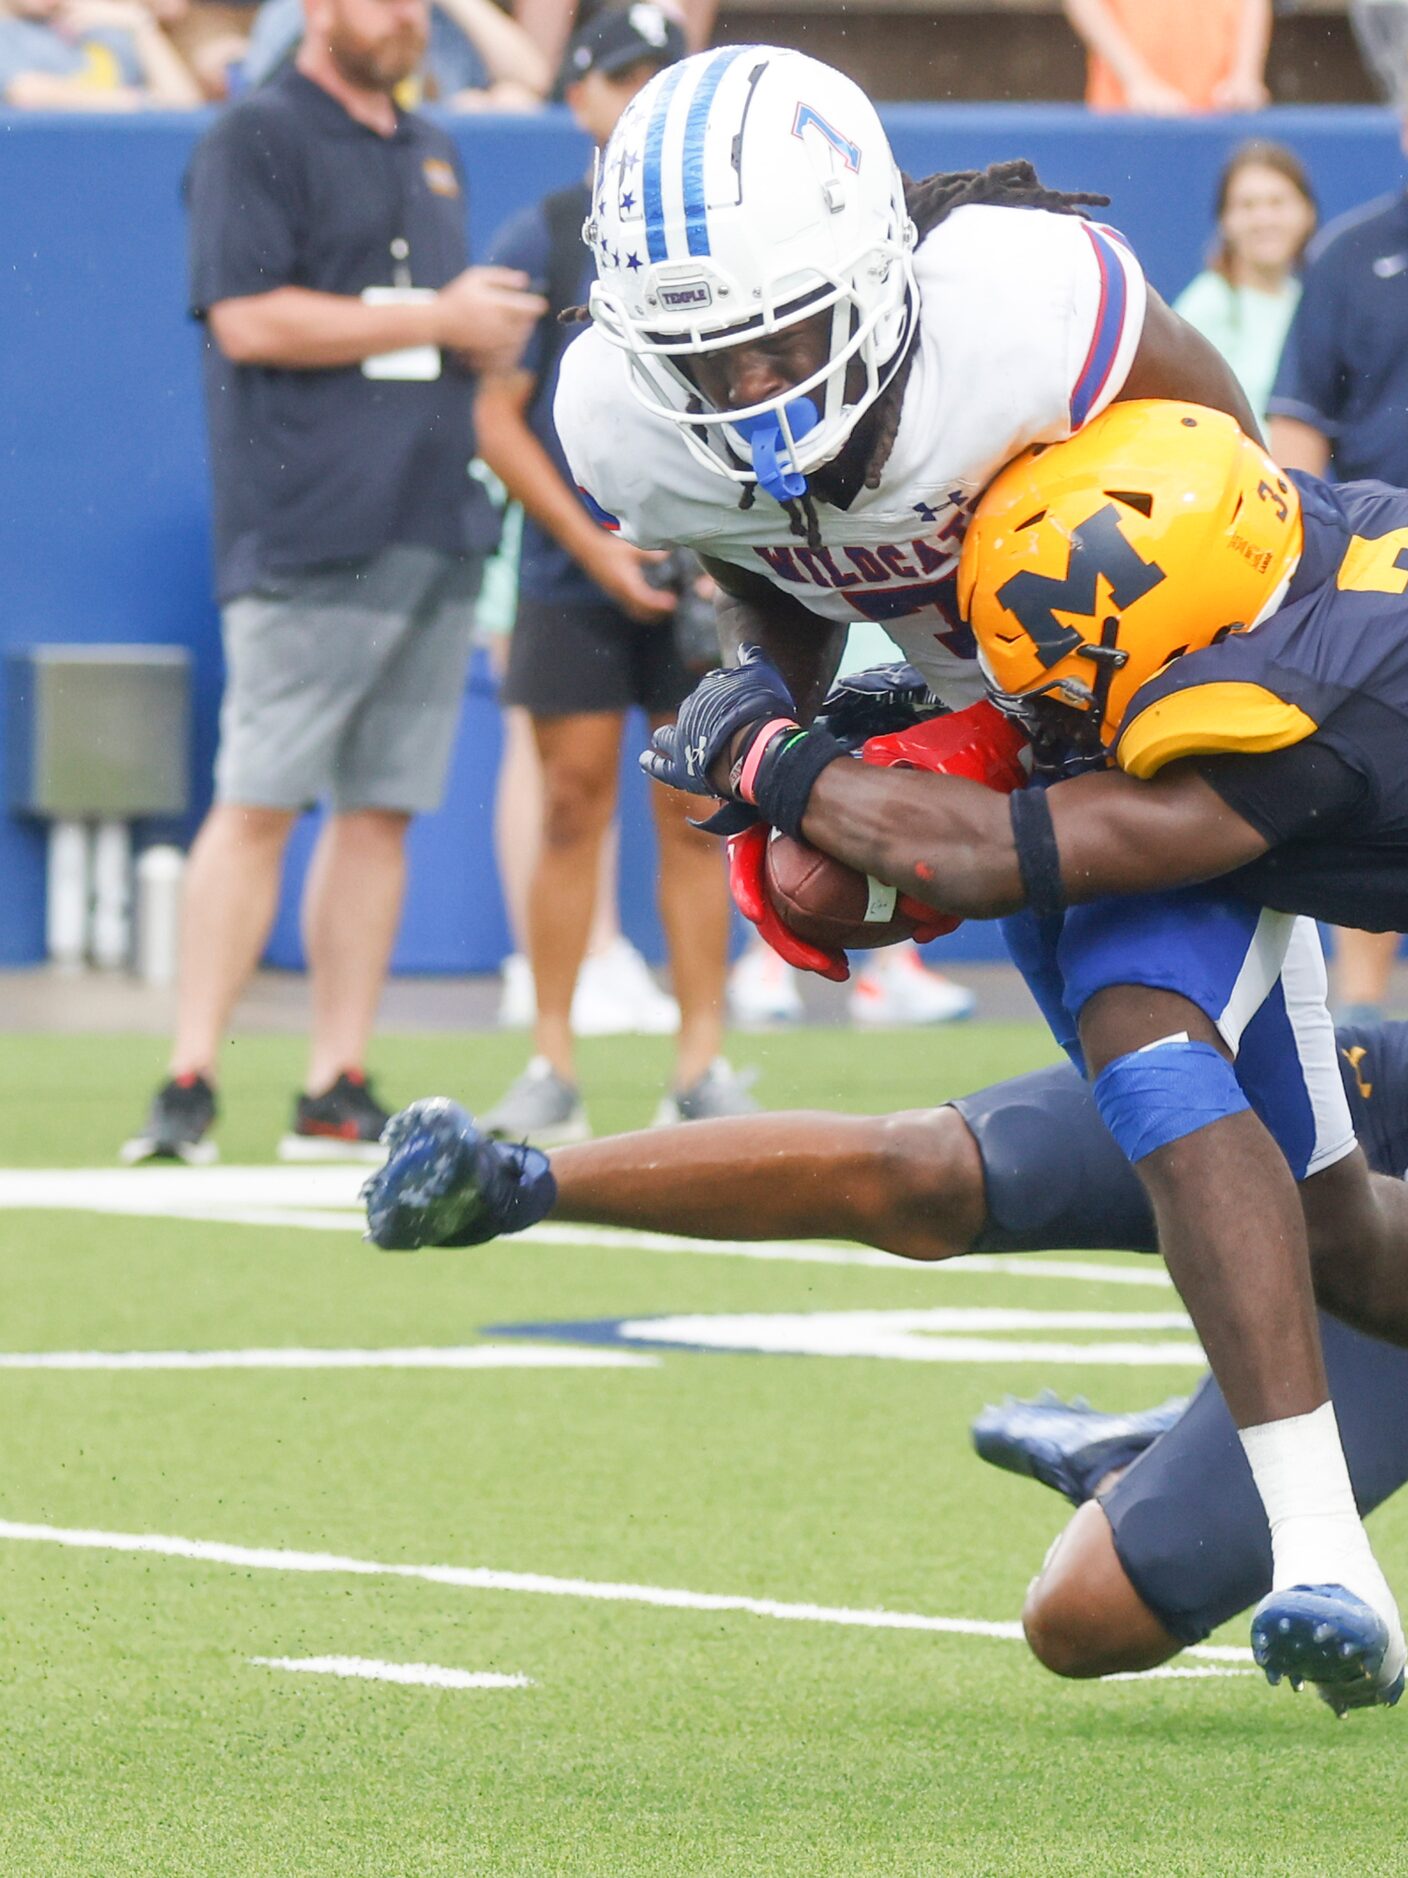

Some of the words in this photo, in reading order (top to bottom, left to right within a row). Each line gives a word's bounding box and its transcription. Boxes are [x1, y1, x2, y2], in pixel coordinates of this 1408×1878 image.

[791, 101, 862, 174] 7
[661, 288, 707, 305] TEMPLE
[1257, 480, 1288, 523] 3
[752, 492, 985, 588] WILDCAT
[994, 502, 1168, 670] M
